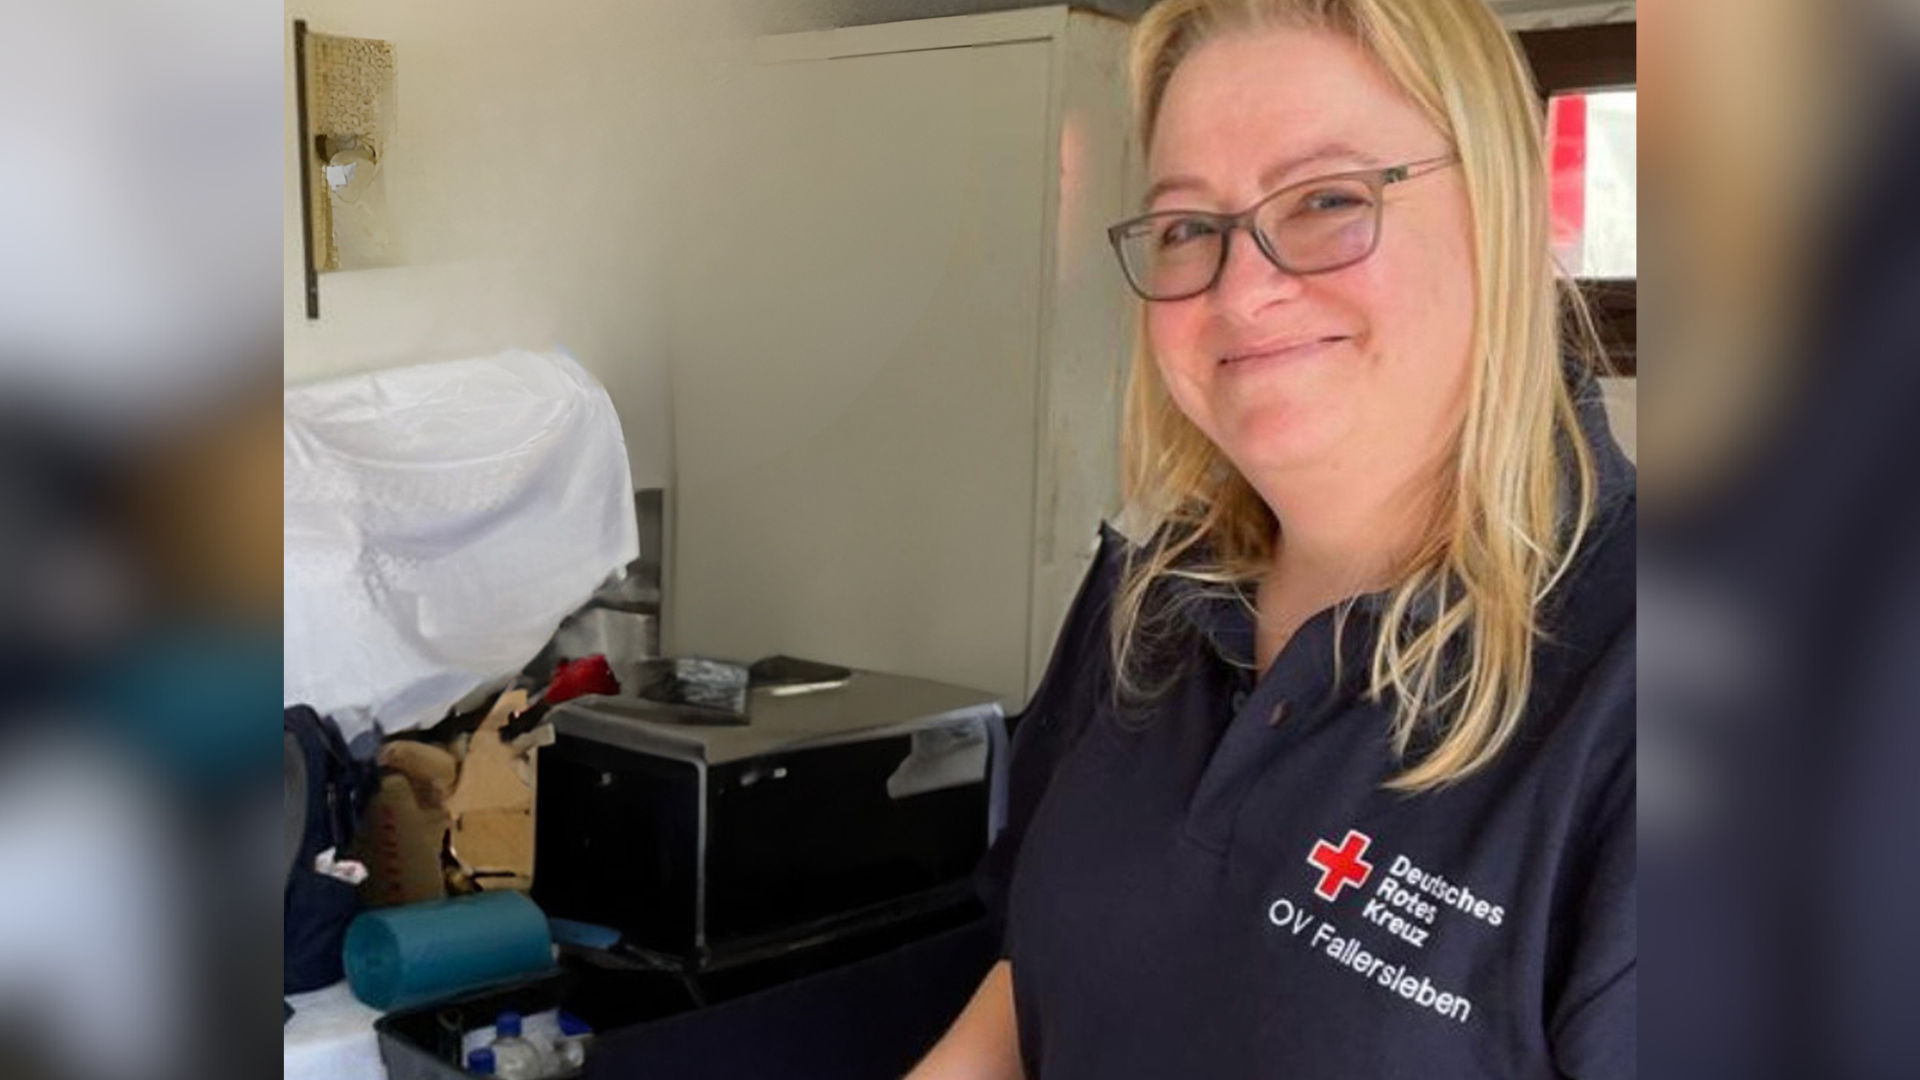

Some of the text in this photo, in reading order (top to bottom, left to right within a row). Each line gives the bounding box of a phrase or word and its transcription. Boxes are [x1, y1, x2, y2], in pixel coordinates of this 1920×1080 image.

[1376, 877, 1437, 924] Rotes
[1389, 855, 1505, 926] Deutsches
[1362, 898, 1429, 947] Kreuz
[1269, 899, 1471, 1023] OV Fallersleben
